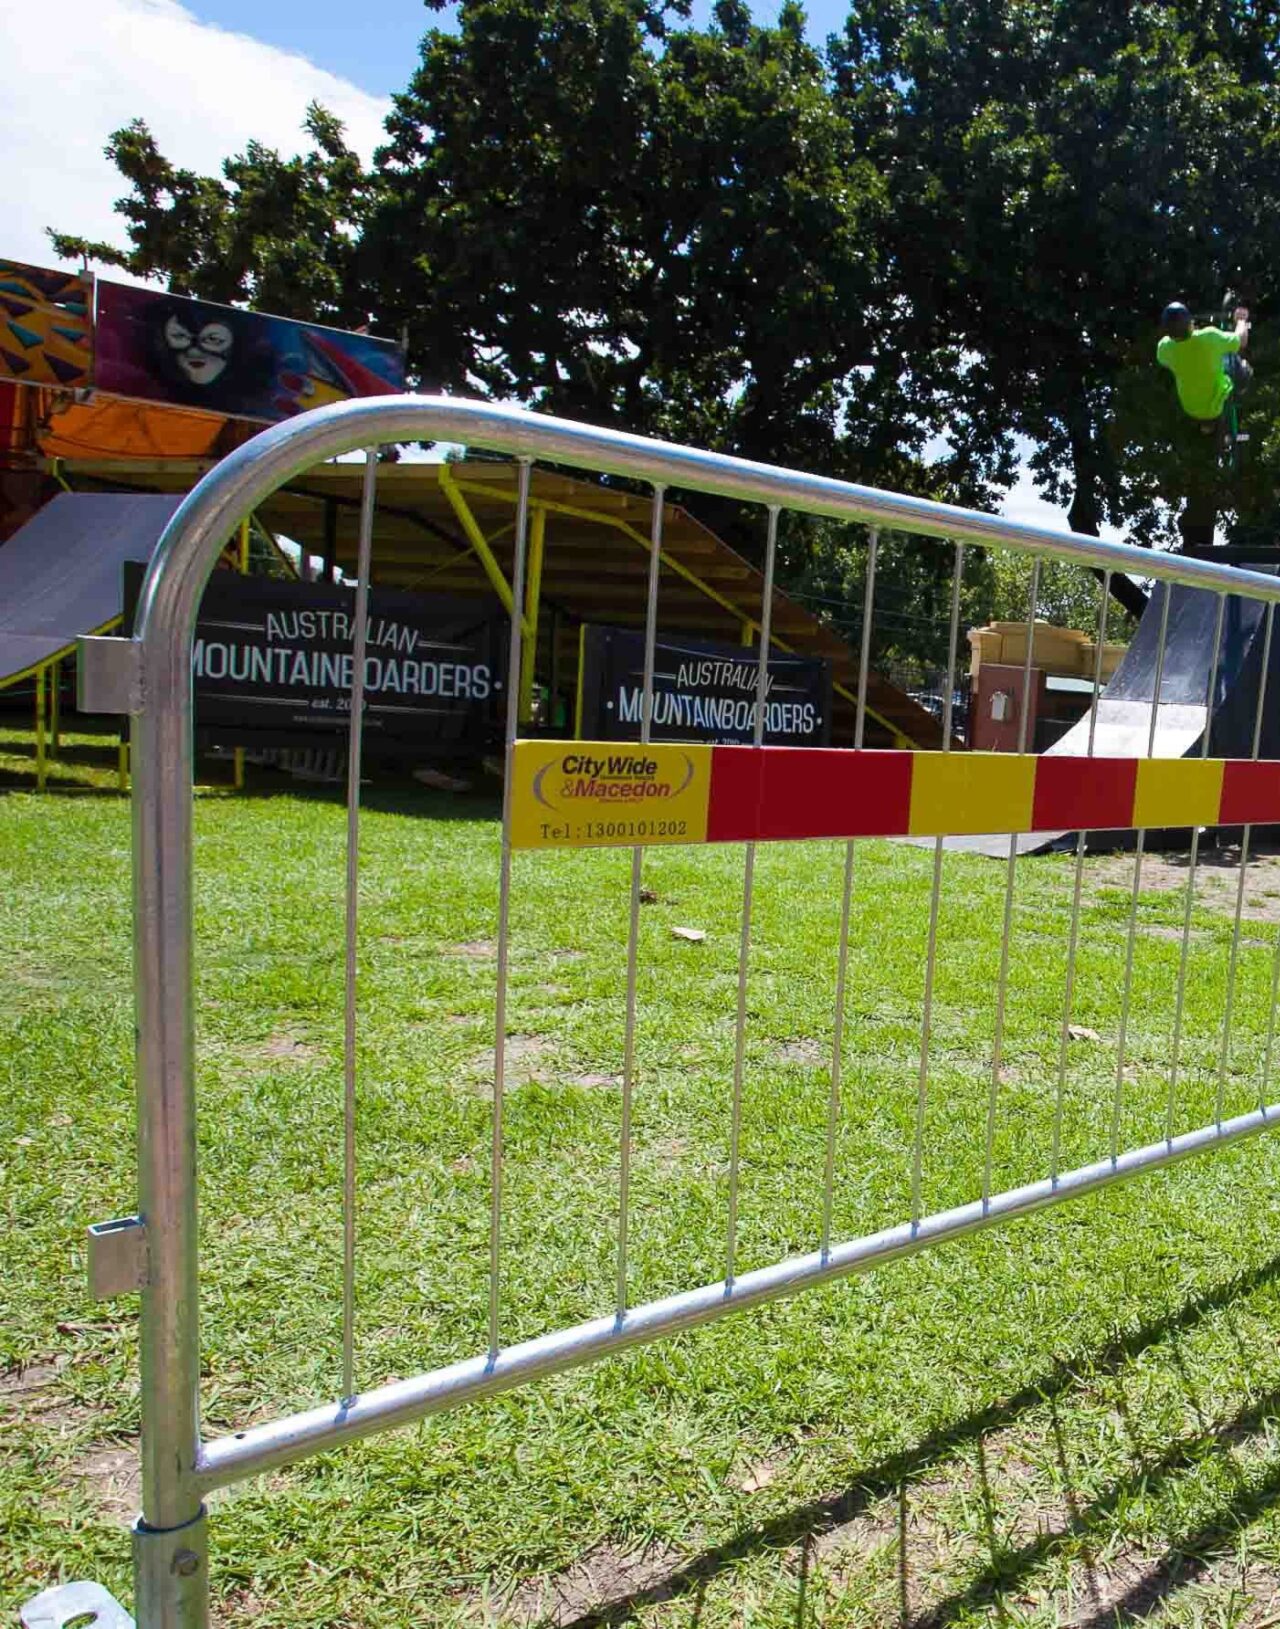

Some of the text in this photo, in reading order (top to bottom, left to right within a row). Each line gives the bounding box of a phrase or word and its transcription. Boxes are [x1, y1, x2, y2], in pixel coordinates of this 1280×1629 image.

[677, 660, 774, 697] AUSTRALIAN
[619, 686, 815, 734] MOUNTAINBOARDERS
[562, 755, 658, 779] City Wide
